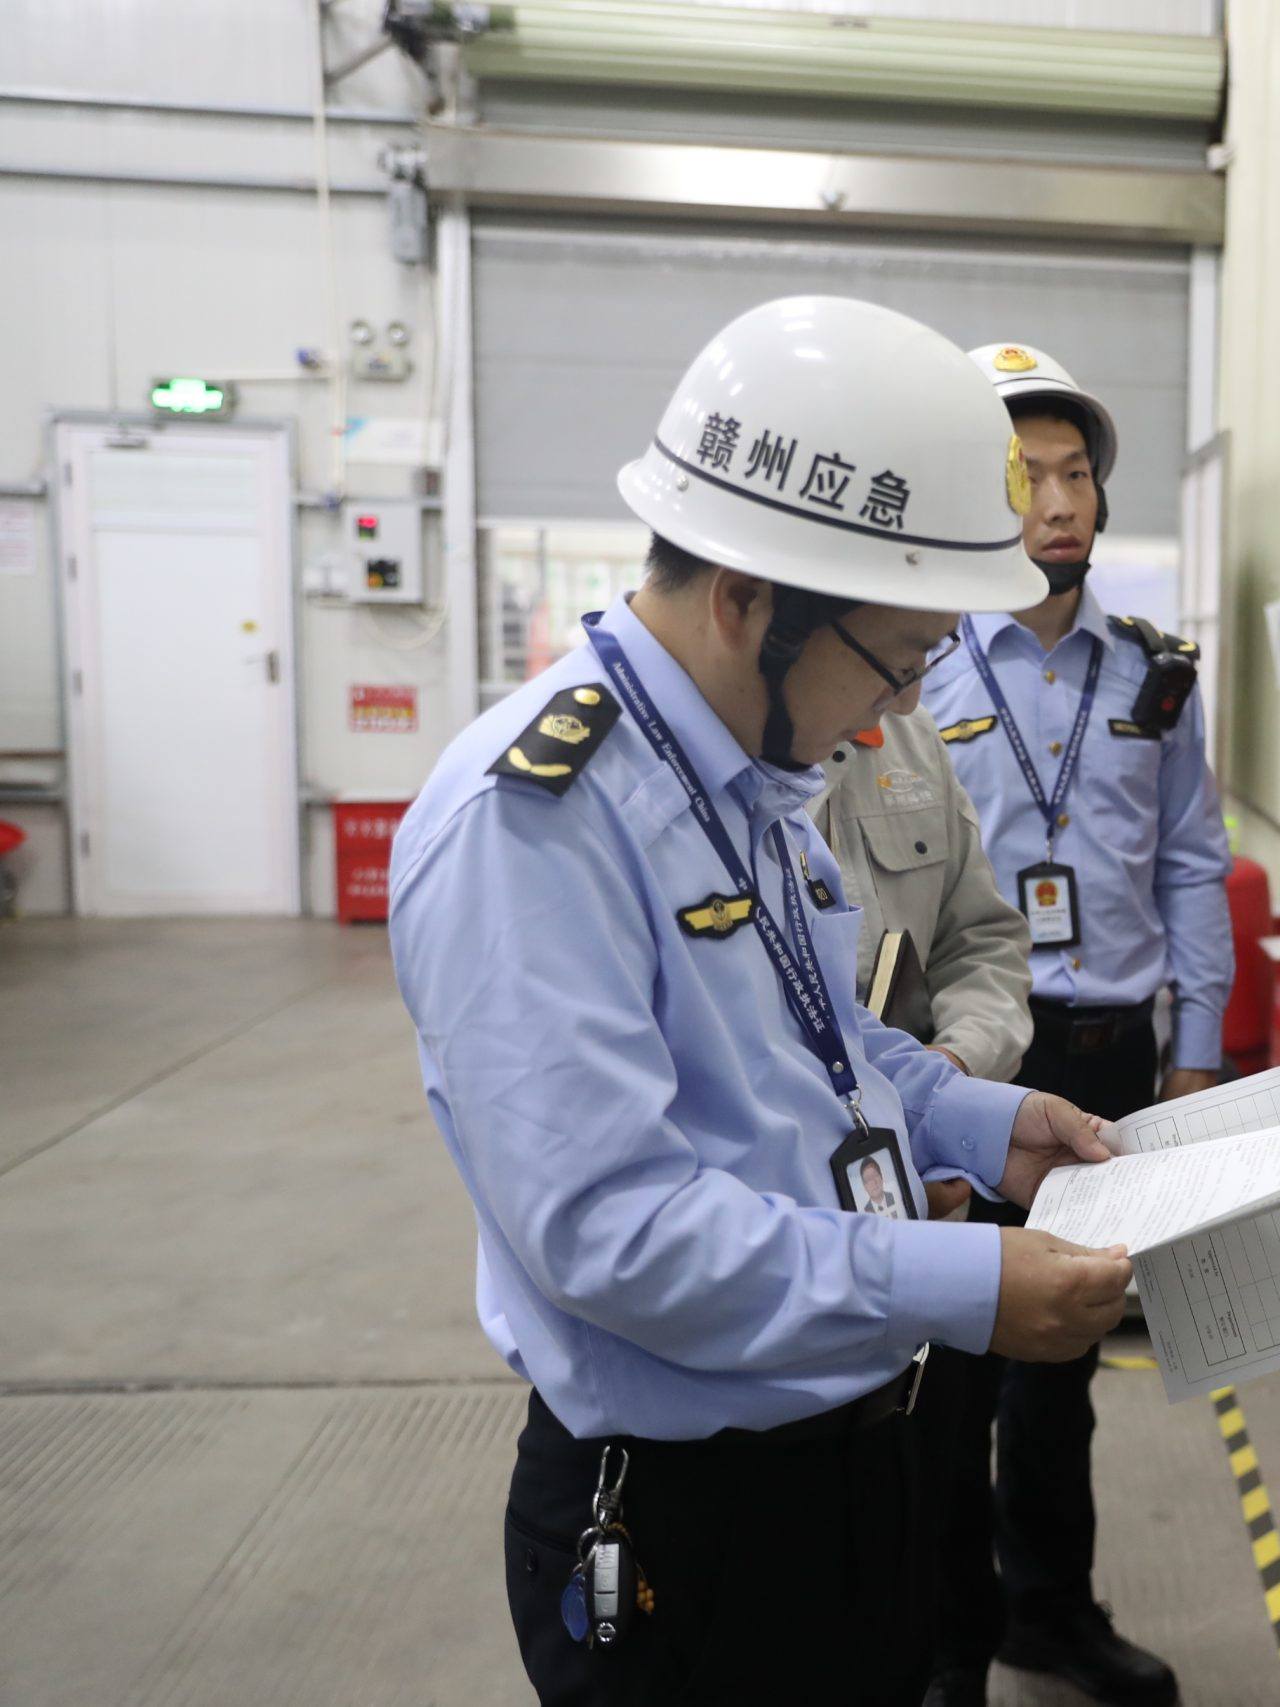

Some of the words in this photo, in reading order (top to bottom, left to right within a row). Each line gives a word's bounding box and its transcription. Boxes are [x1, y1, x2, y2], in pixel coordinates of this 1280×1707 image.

[696, 411, 912, 531] 赣州应急
[612, 661, 650, 721] Administrative
[647, 720, 664, 742] Law
[661, 742, 698, 796] Enforcement
[694, 795, 711, 823] China
